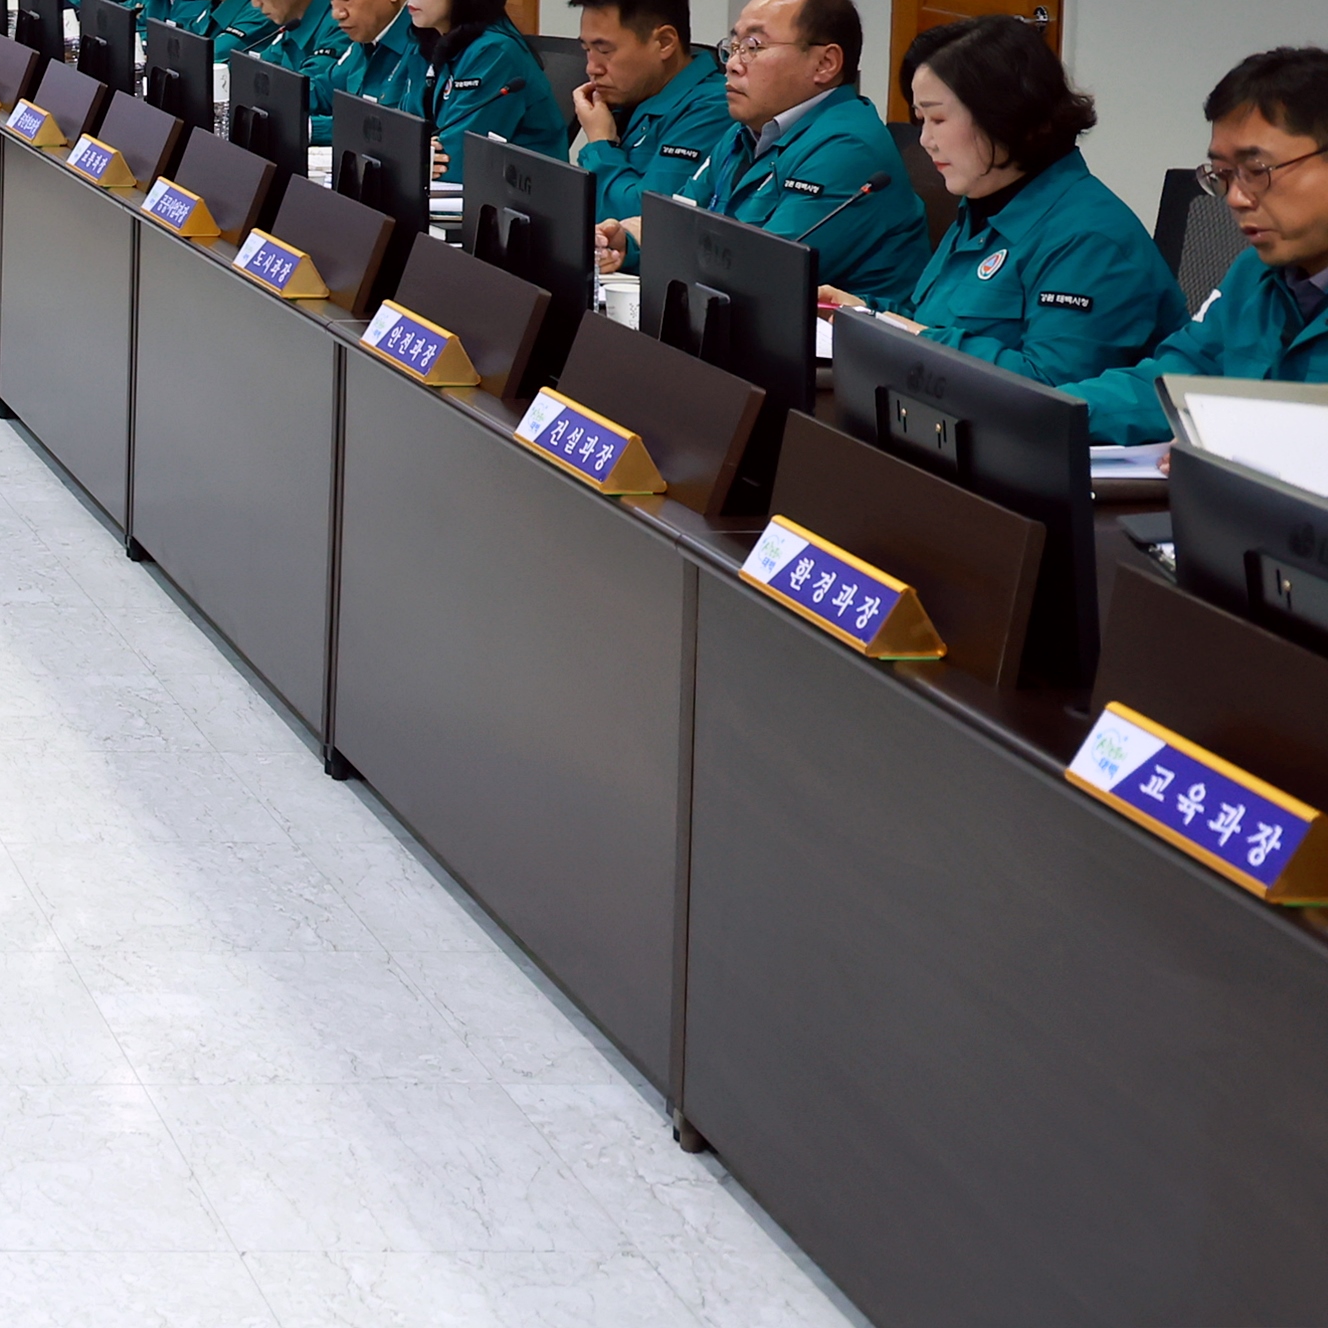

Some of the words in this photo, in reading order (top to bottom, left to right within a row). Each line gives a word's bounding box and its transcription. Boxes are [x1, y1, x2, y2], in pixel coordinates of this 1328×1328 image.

[80, 149, 109, 174] 교통과장
[253, 250, 293, 283] 도시과장
[1056, 294, 1090, 308] 태백시청
[387, 325, 438, 367] 안전과장
[549, 419, 615, 471] 건설과장
[789, 557, 882, 630] 환경과장
[1138, 762, 1285, 868] 교육과장
